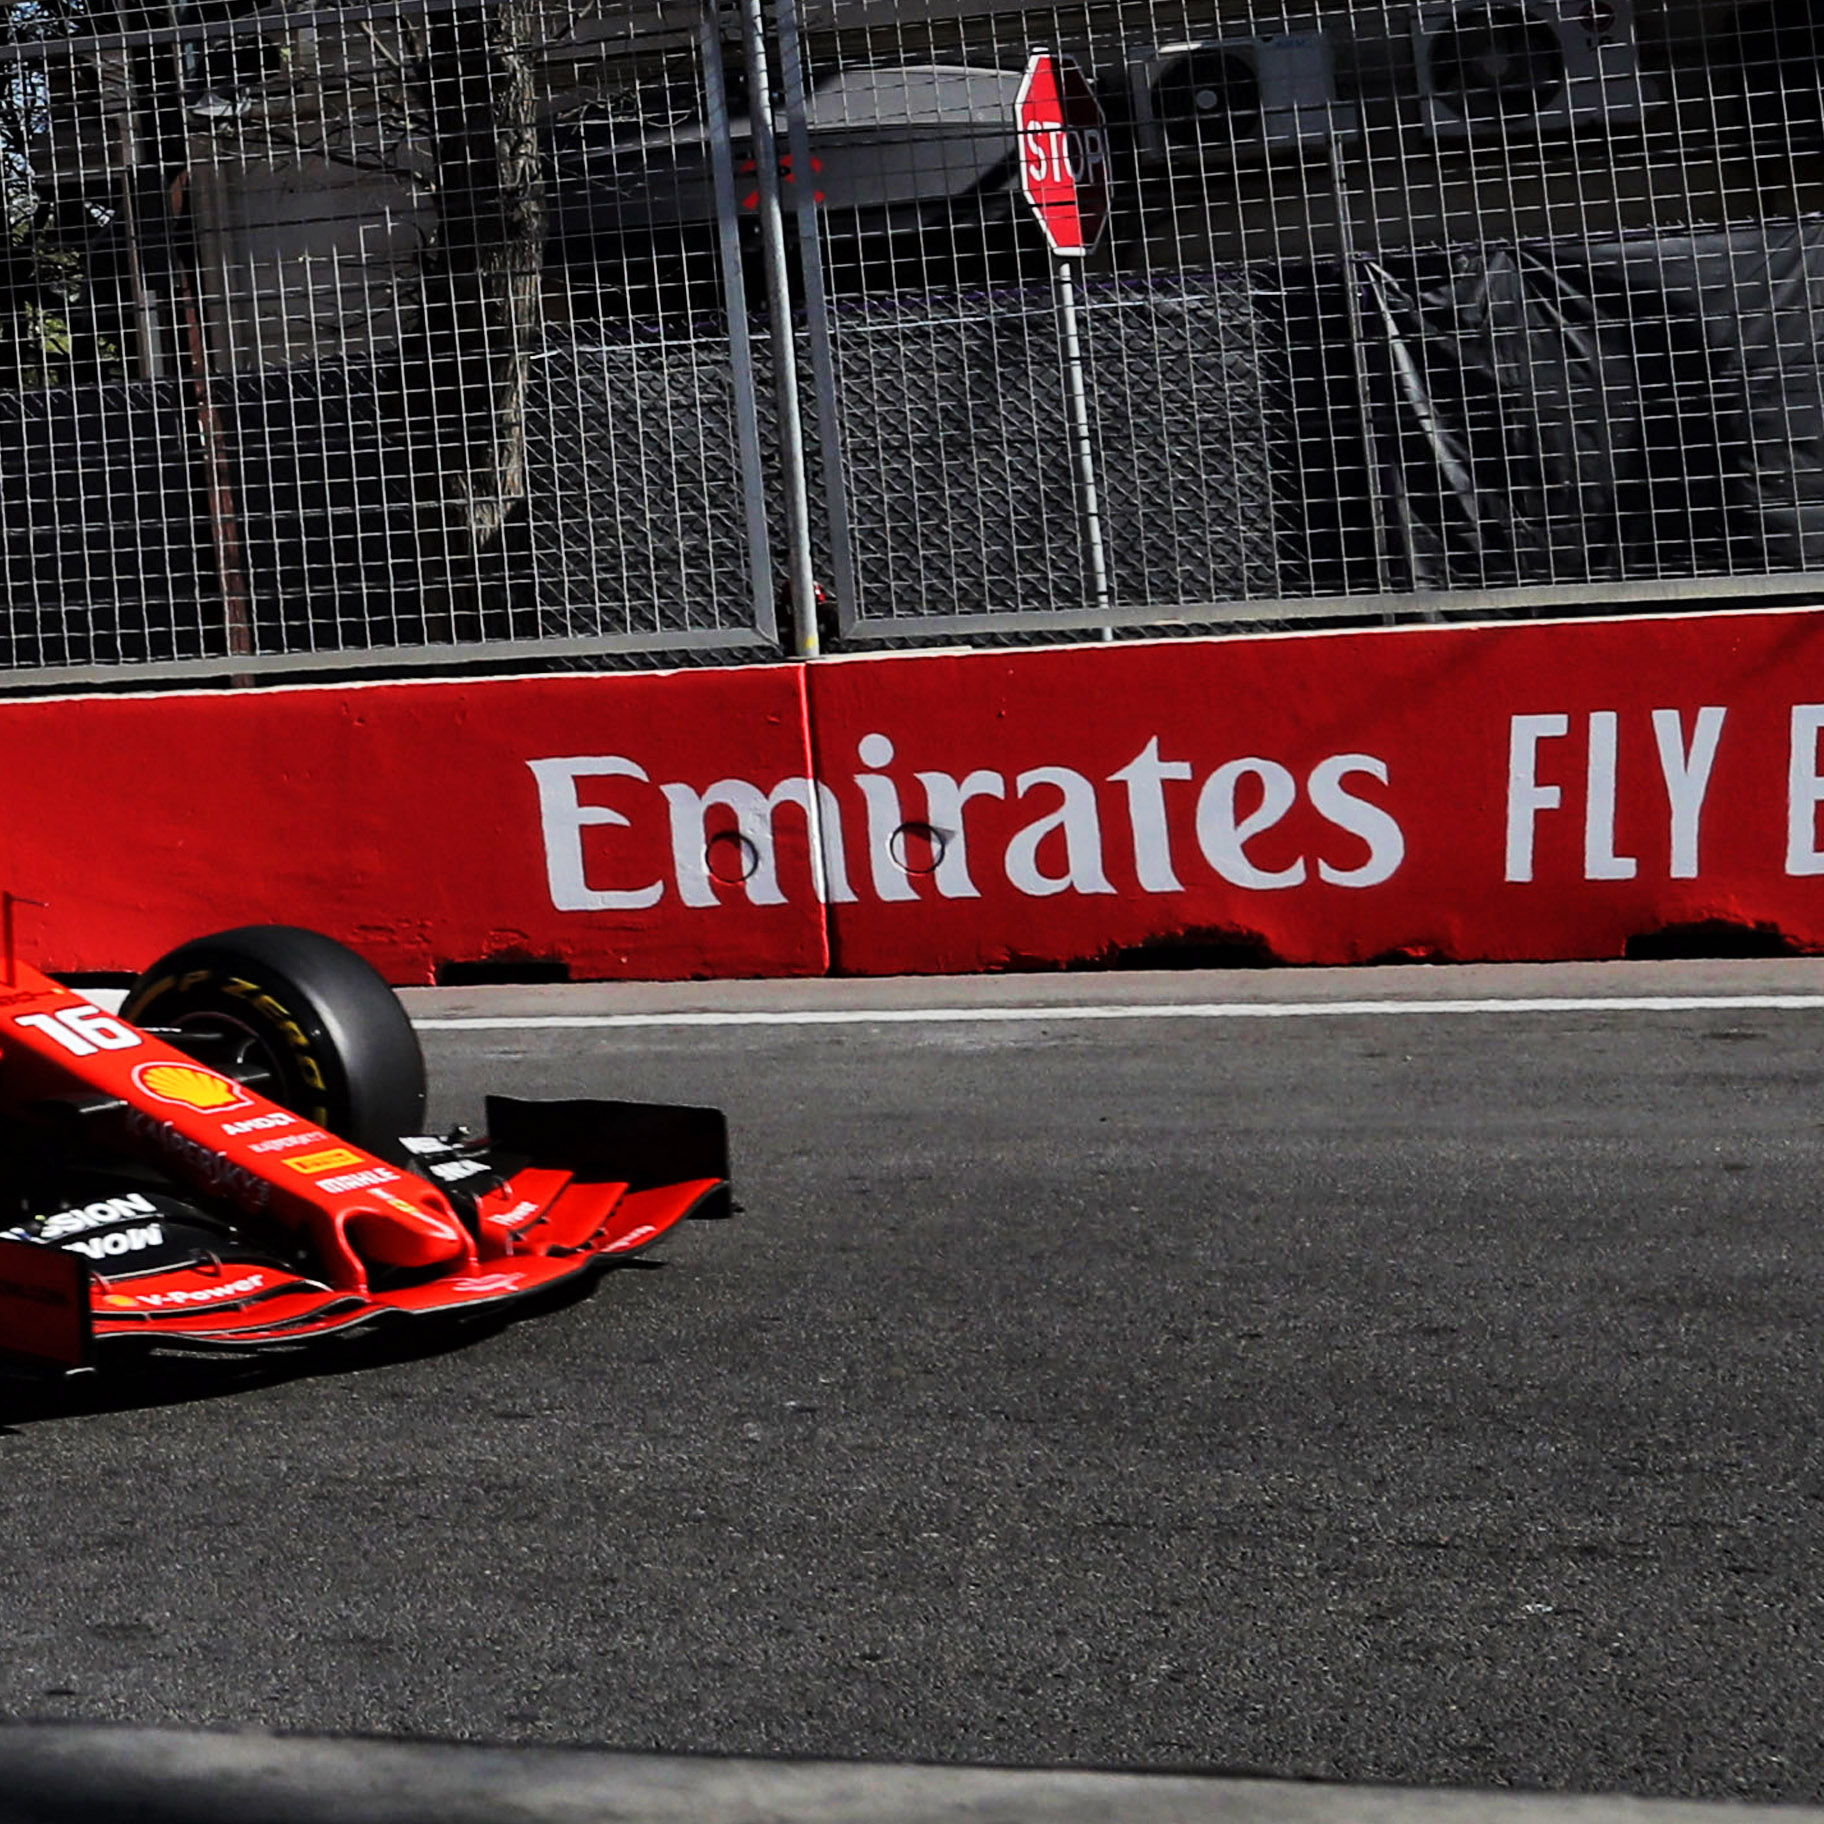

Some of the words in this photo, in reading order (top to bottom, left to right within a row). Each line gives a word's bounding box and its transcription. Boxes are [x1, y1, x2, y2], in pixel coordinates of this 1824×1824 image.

[1027, 121, 1104, 184] STOP
[527, 732, 1405, 913] Emirates
[1505, 706, 1728, 884] FLY
[15, 1003, 143, 1057] 16
[315, 1167, 401, 1195] MAHLE
[137, 1274, 263, 1306] V-Power
